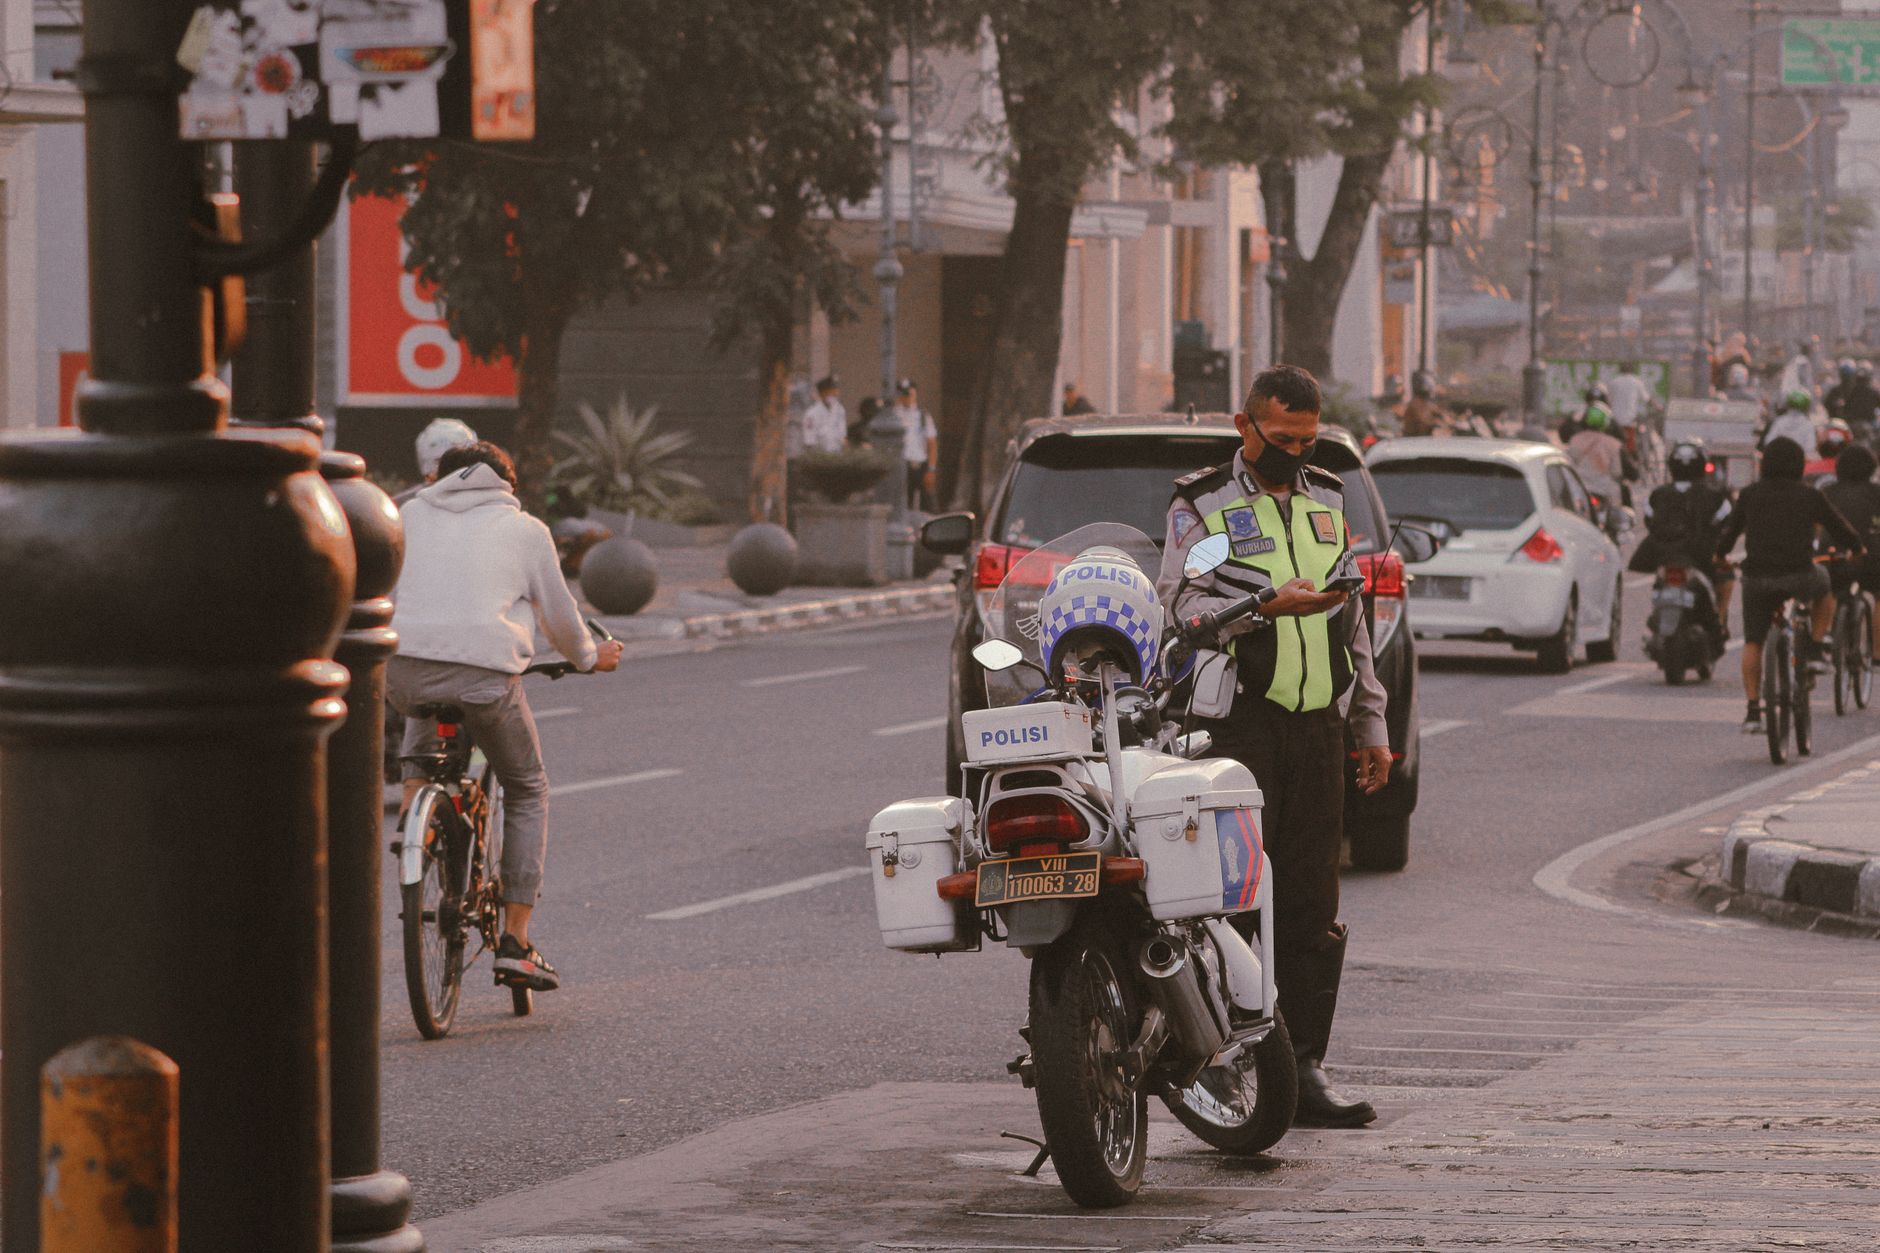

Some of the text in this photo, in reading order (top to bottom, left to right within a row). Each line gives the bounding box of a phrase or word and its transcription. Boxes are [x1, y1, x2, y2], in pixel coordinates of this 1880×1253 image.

[1235, 539, 1274, 556] NURHADI
[1063, 566, 1139, 590] POLISI
[981, 726, 1048, 747] POLISI
[1040, 858, 1067, 871] VIII
